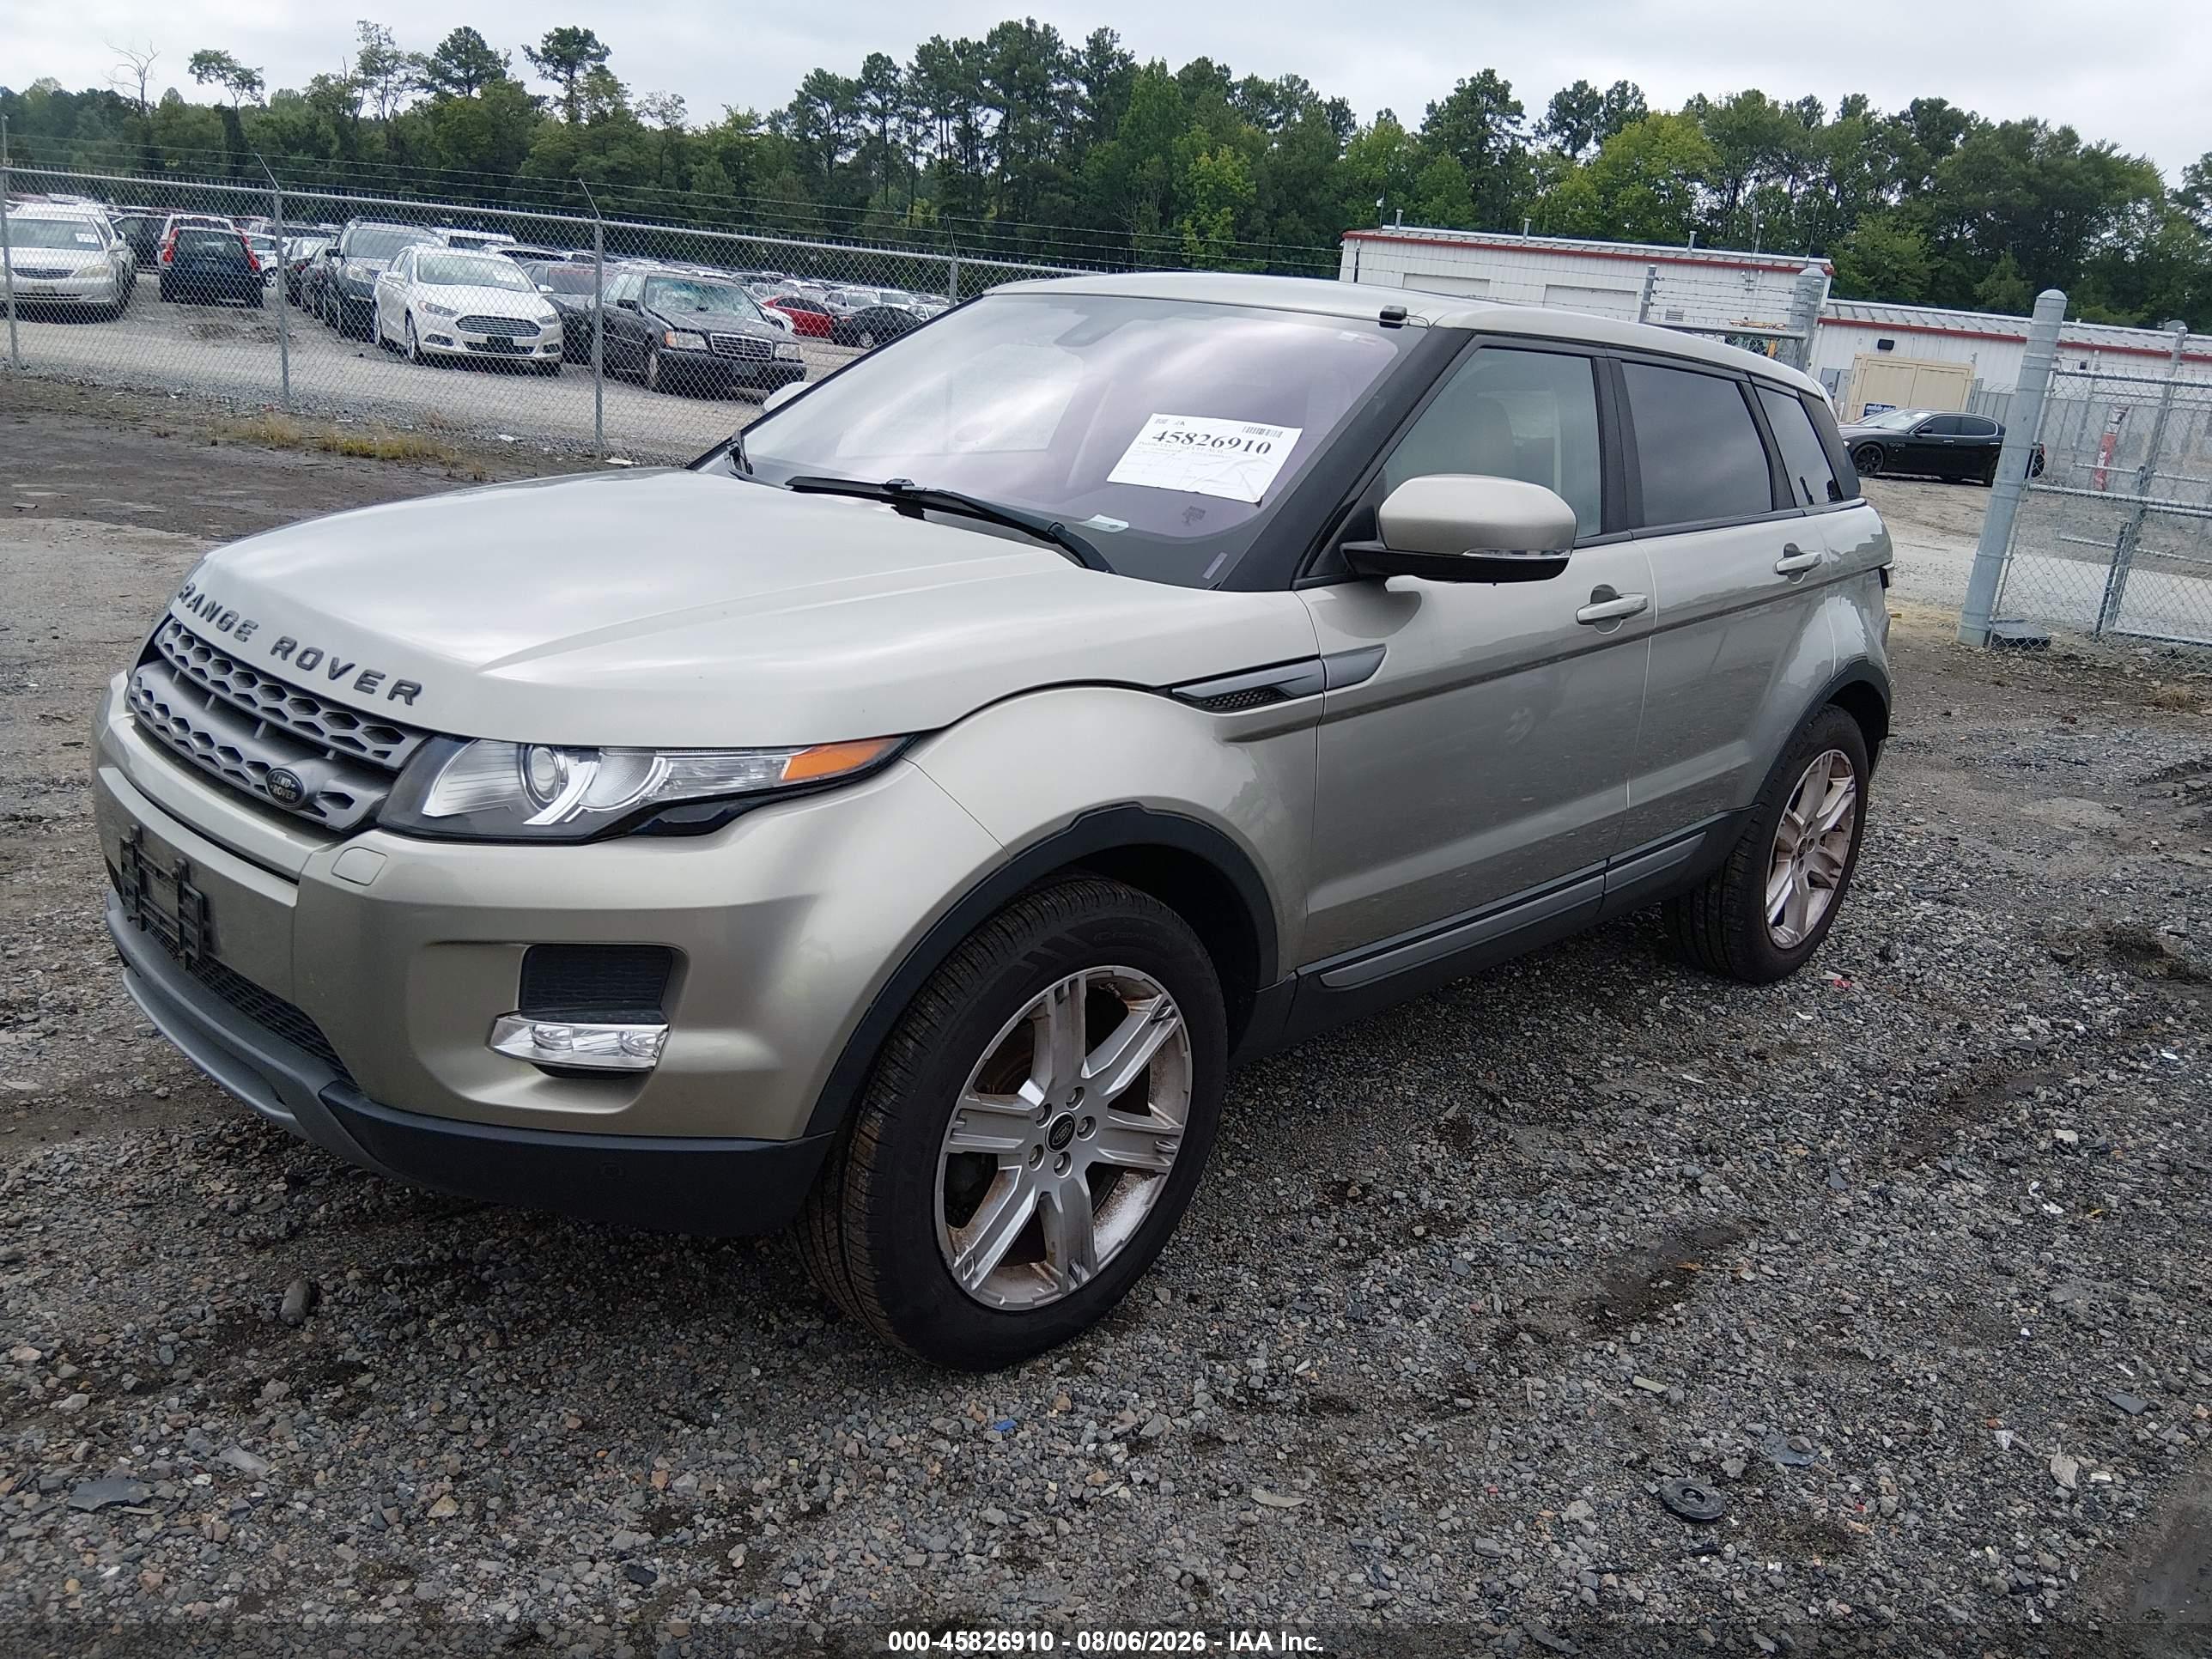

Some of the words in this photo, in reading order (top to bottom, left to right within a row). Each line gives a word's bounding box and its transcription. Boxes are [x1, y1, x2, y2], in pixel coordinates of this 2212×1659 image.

[1152, 430, 1272, 455] 45826910
[178, 582, 258, 642] RANGE
[270, 635, 422, 706] ROVER
[273, 784, 296, 800] ROVER
